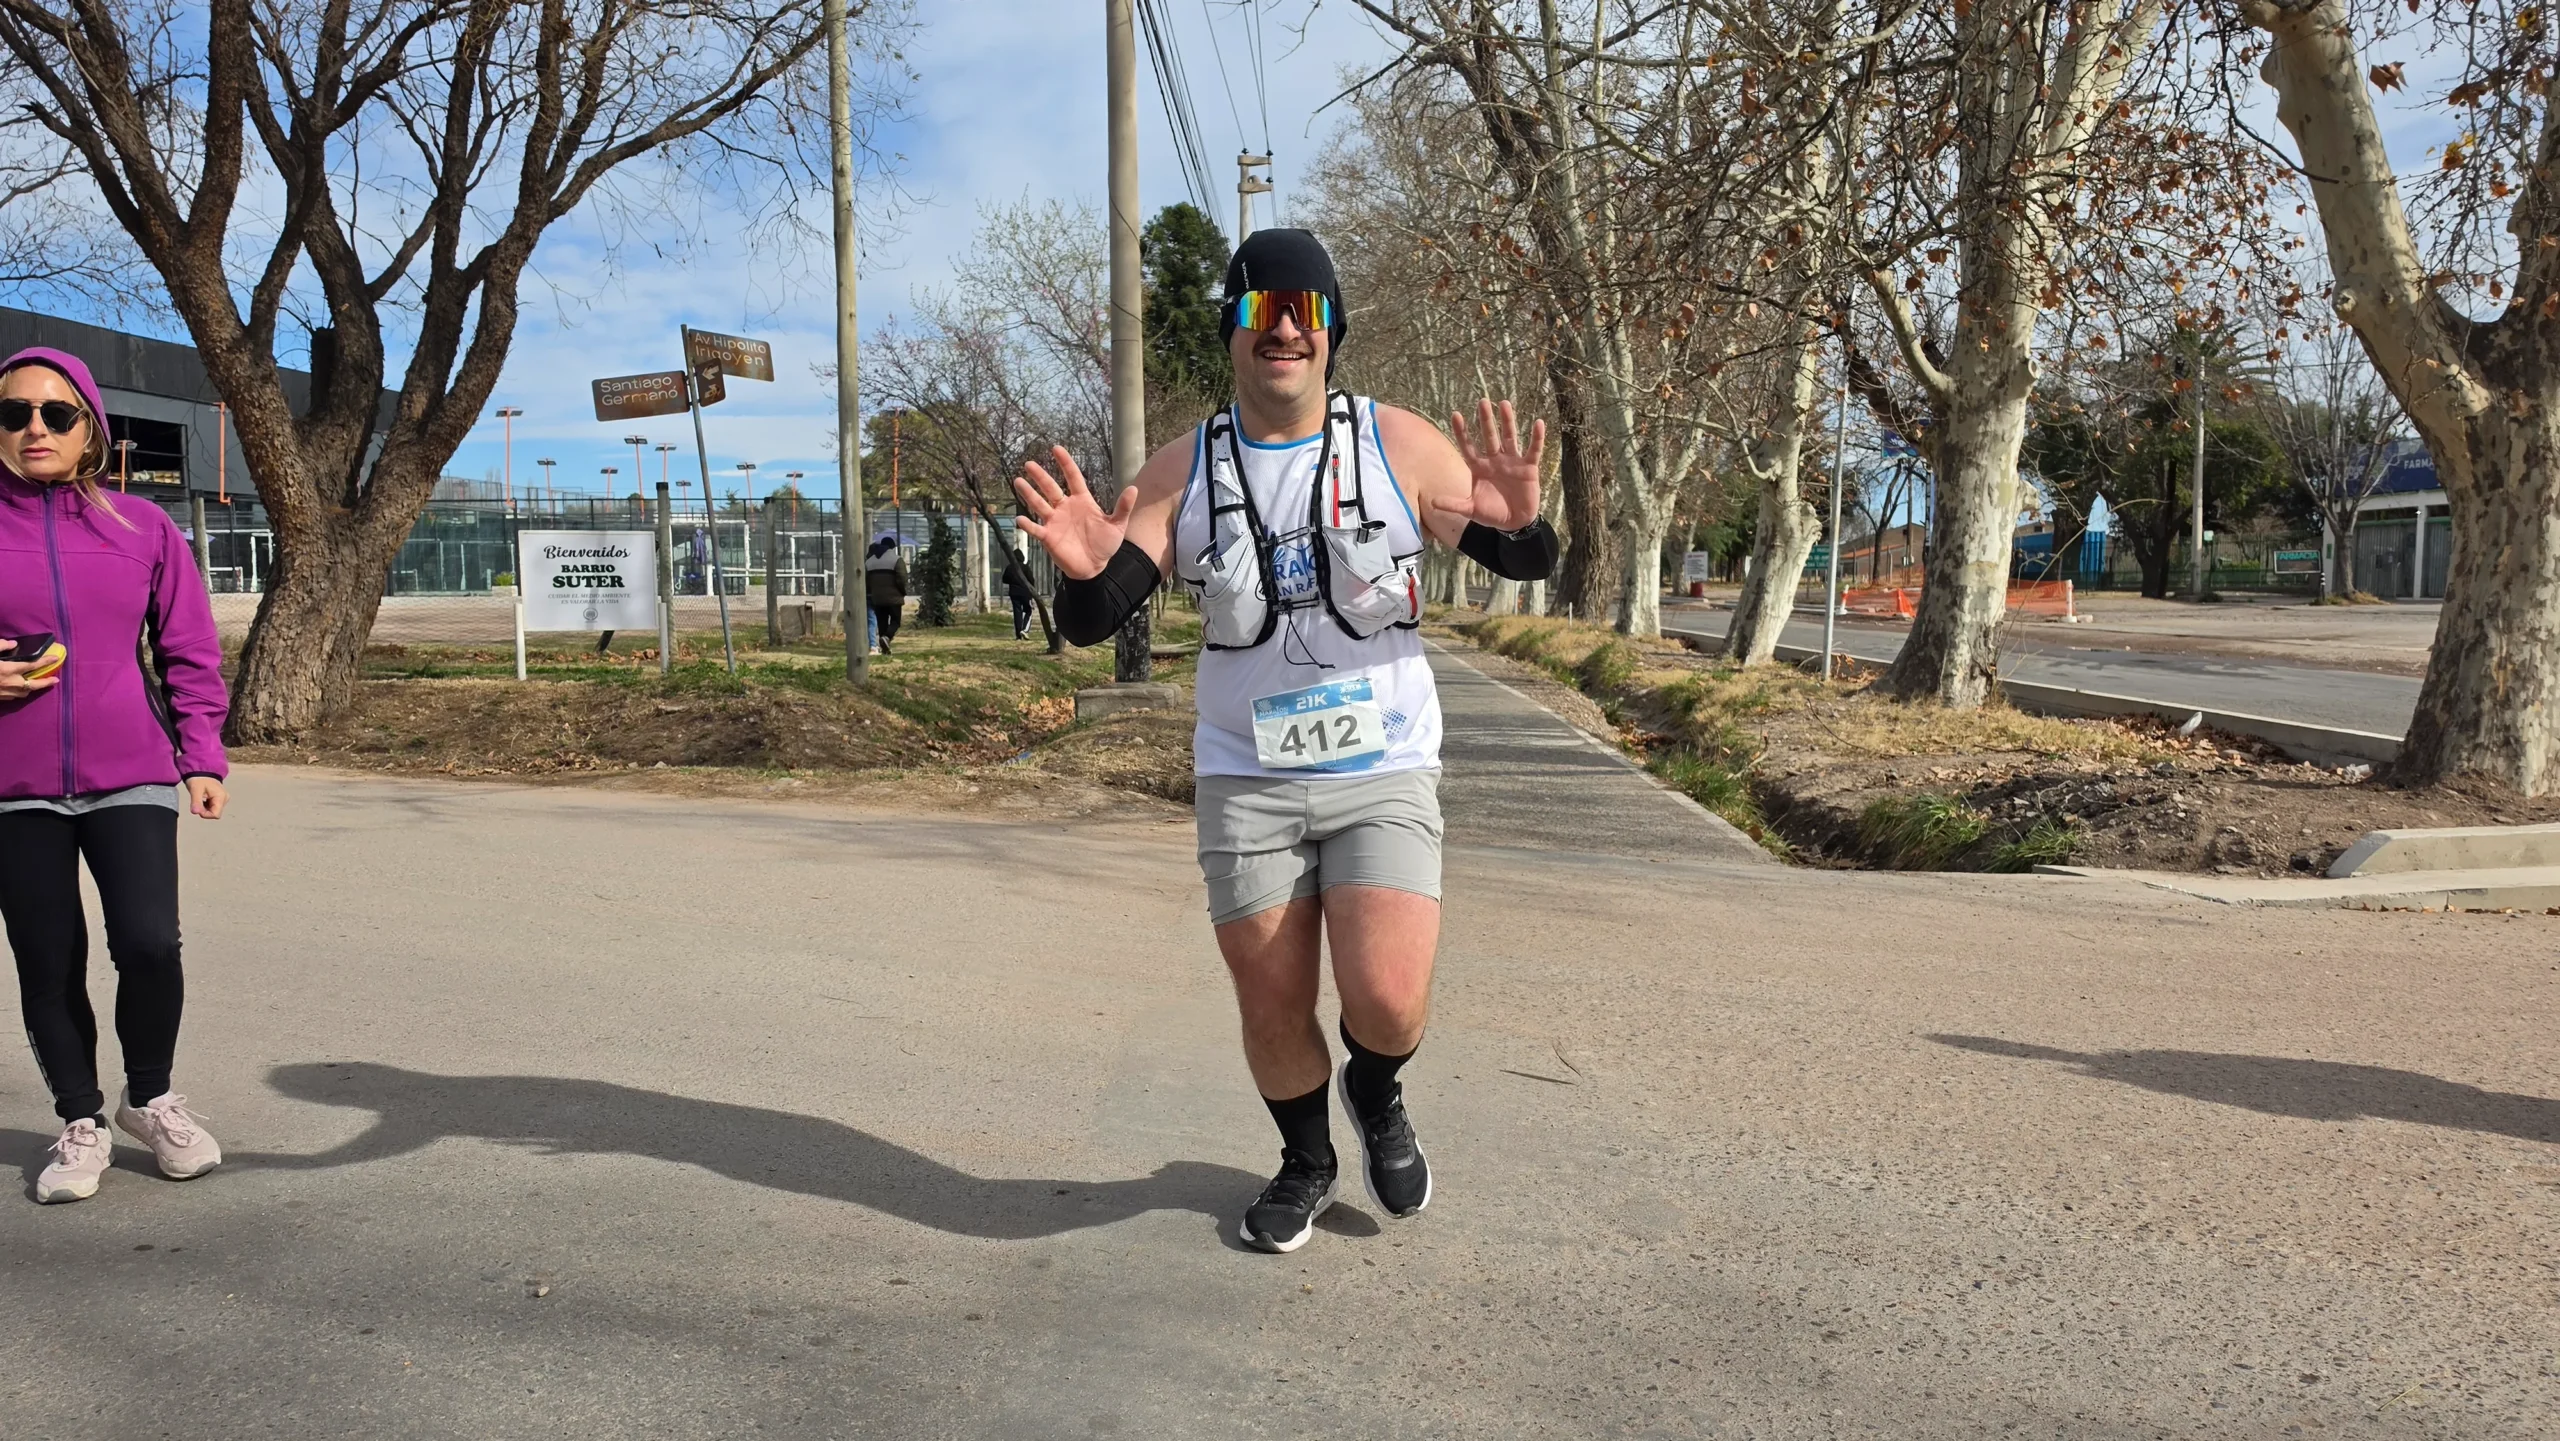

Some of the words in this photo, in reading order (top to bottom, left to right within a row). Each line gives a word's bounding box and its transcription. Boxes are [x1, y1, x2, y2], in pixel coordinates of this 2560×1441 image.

[600, 376, 672, 393] Santiago
[601, 386, 678, 406] Germanó
[2404, 456, 2435, 470] FARMA
[543, 545, 631, 559] Bienvenidos
[561, 564, 616, 573] BARRIO
[552, 575, 625, 588] SUTER
[1296, 692, 1328, 710] 21K
[1280, 715, 1362, 757] 412
